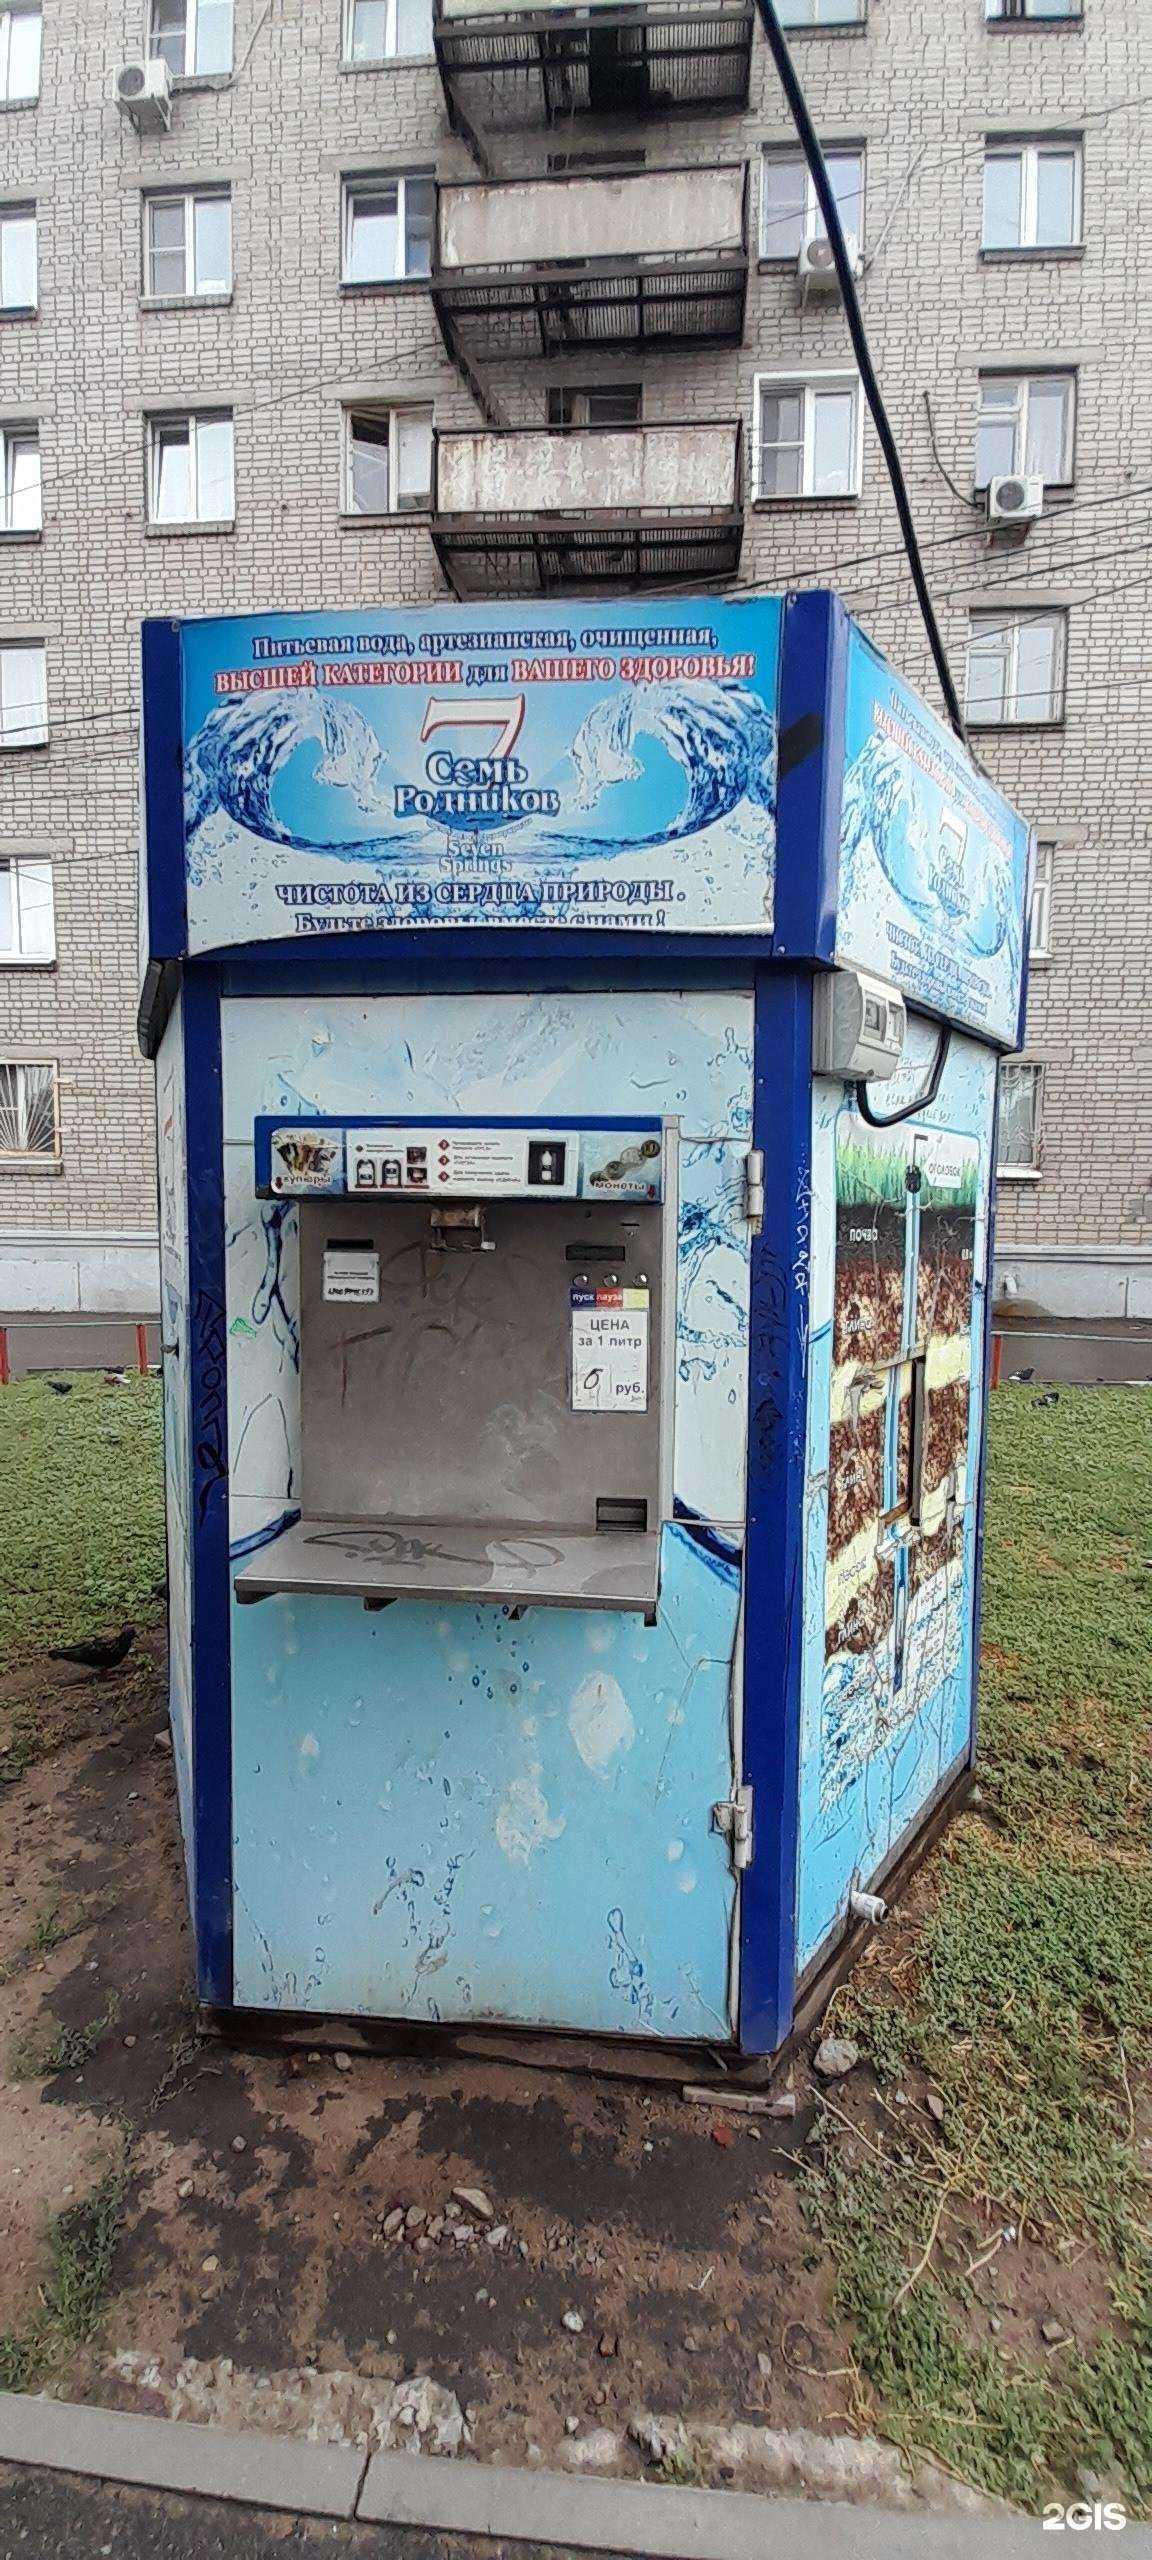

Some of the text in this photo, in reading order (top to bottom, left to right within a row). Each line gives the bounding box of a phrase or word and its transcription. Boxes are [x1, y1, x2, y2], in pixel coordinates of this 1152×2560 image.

[253, 627, 719, 660] Питьевая вода, артезианская, очищенная,
[214, 653, 756, 694] ВЫСШЕЙ КАТЕГОРИИ для ВАШЕГО ЗДОРОВЬЯ!
[420, 693, 526, 788] 7
[426, 750, 529, 787] Семь
[393, 783, 562, 816] Родников
[446, 838, 505, 857] Seven
[439, 855, 513, 875] Springs
[275, 882, 393, 906] ЧИСТОТА
[395, 882, 432, 904] ИЗ
[435, 881, 538, 906] СЕРДЦА
[590, 1318, 630, 1332] ЦЕНА
[578, 1335, 642, 1350] за 1 литр
[615, 1382, 645, 1396] руб.
